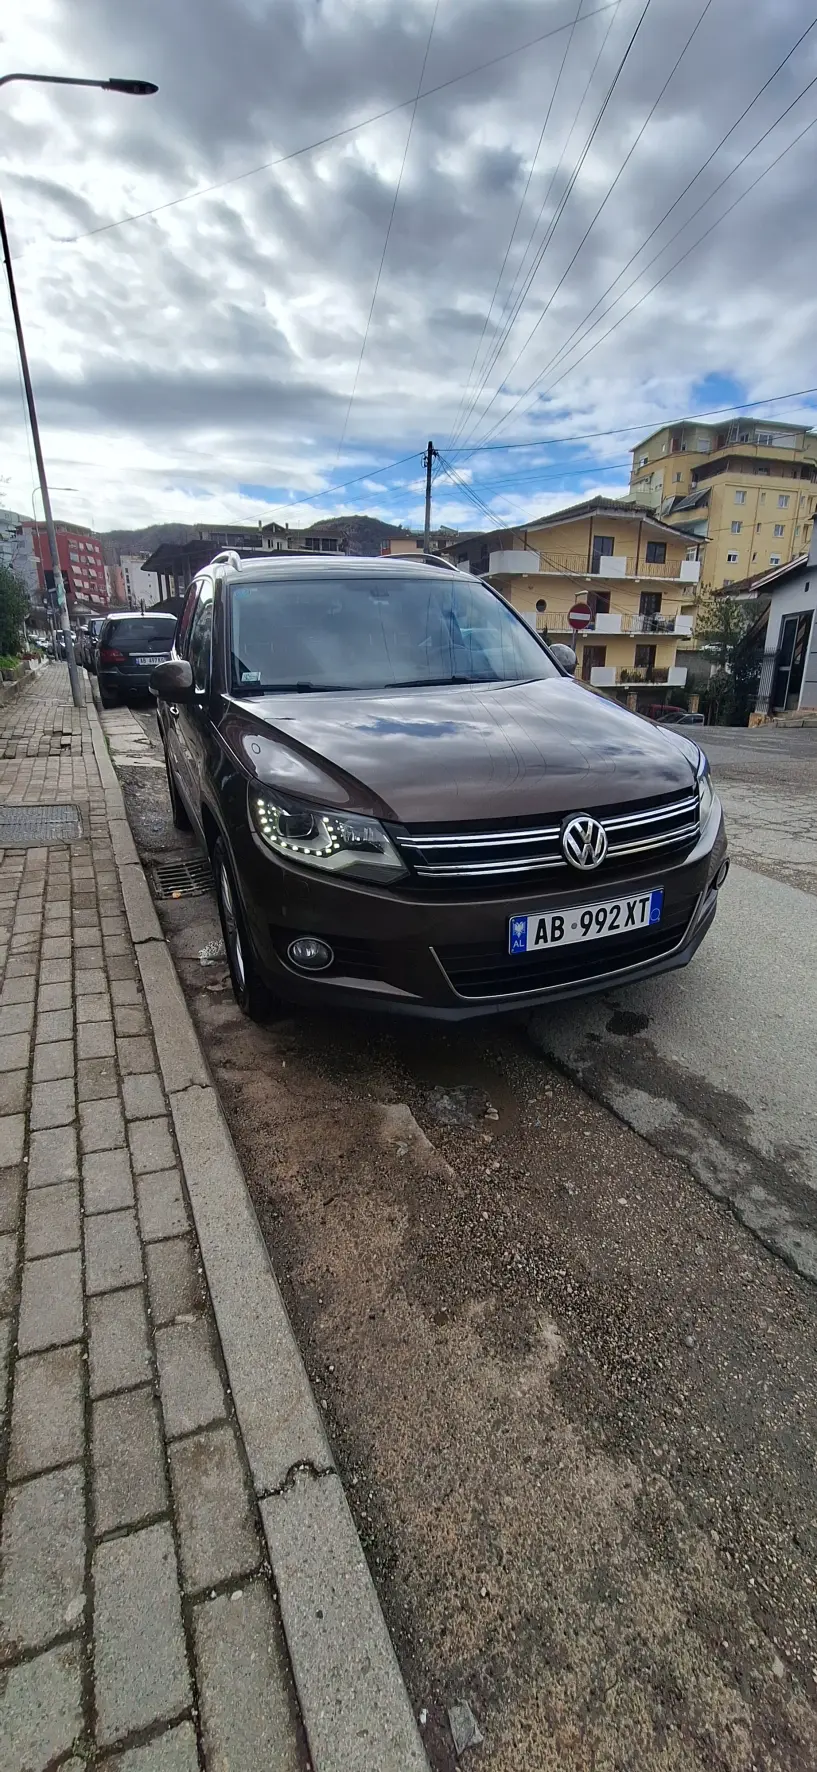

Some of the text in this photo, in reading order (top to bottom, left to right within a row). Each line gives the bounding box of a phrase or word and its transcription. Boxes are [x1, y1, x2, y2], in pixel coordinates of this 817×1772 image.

[564, 818, 606, 868] VW
[513, 940, 525, 948] AL
[534, 916, 565, 945] AB
